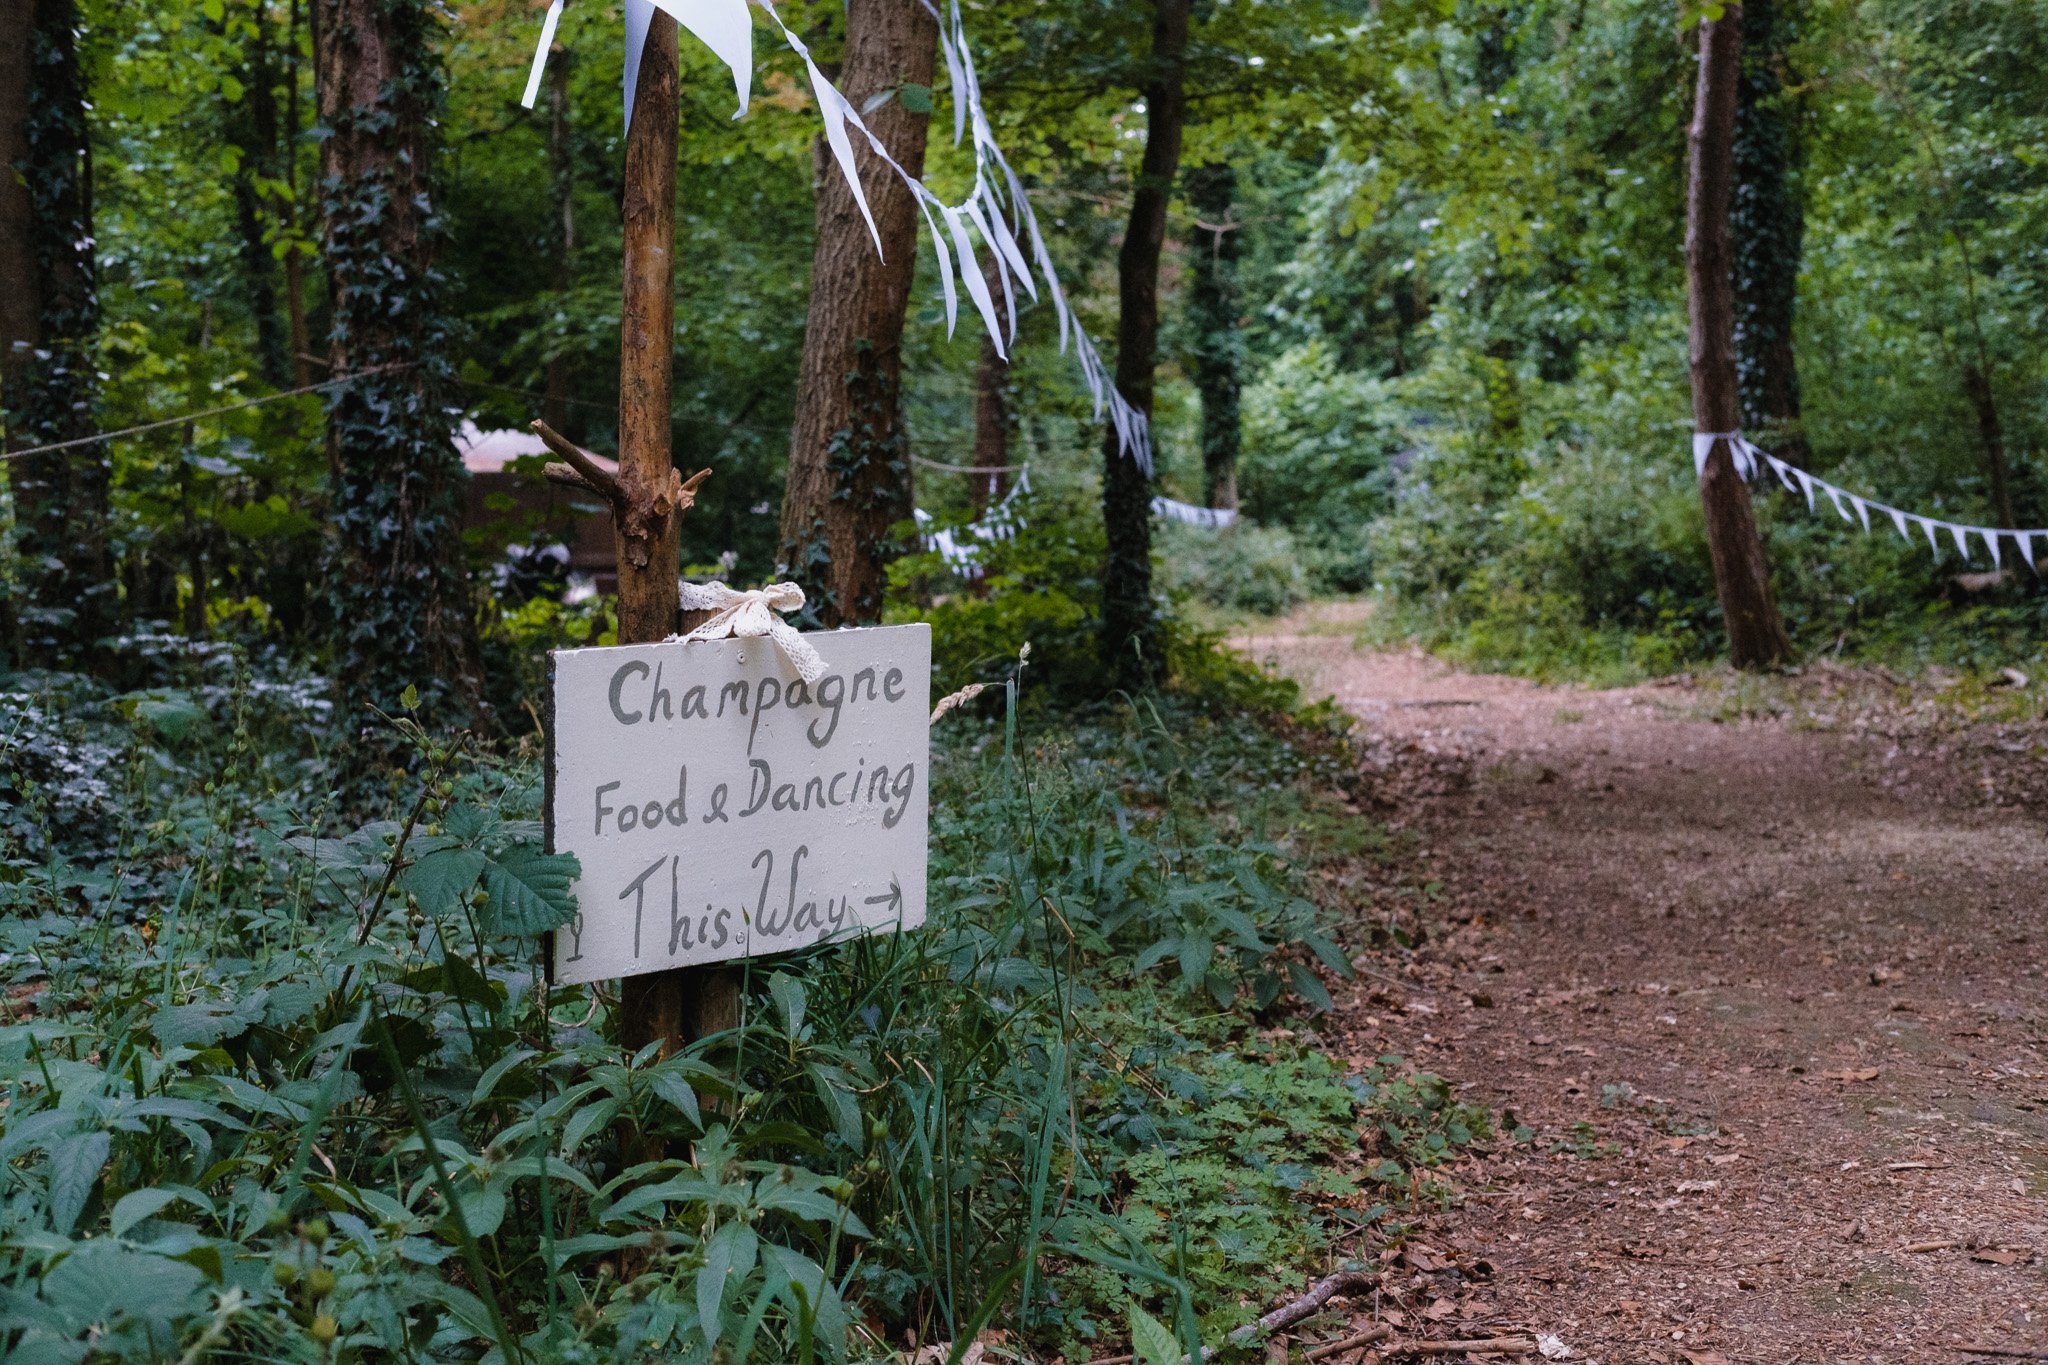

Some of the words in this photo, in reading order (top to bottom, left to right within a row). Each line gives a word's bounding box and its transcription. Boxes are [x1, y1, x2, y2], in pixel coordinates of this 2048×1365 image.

[608, 659, 906, 756] Champagne
[594, 764, 689, 836] Food
[702, 782, 729, 823] &
[739, 757, 915, 829] Dancing
[619, 854, 731, 958] This
[751, 844, 847, 942] Way
